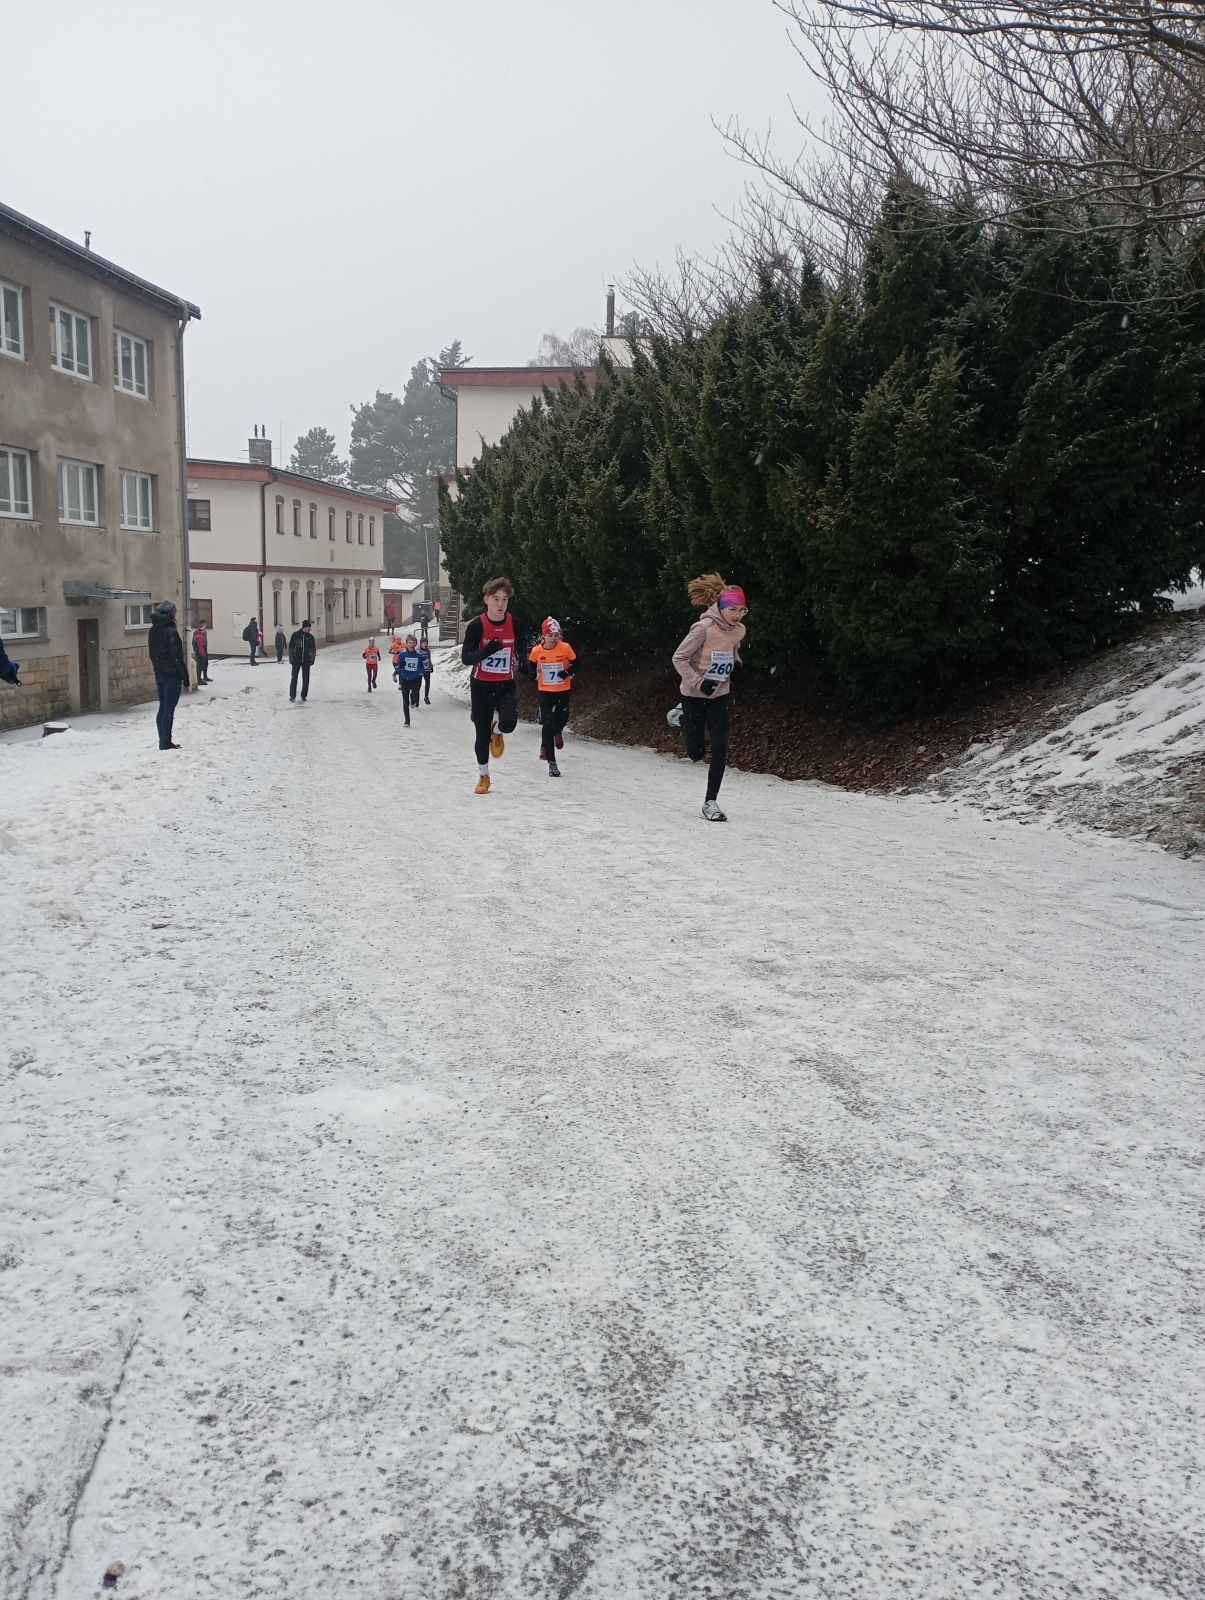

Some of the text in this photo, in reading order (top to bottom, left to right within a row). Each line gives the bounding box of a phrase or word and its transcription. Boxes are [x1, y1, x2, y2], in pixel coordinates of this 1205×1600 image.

[486, 657, 507, 668] 271
[708, 662, 733, 675] 260
[549, 671, 556, 681] 7
